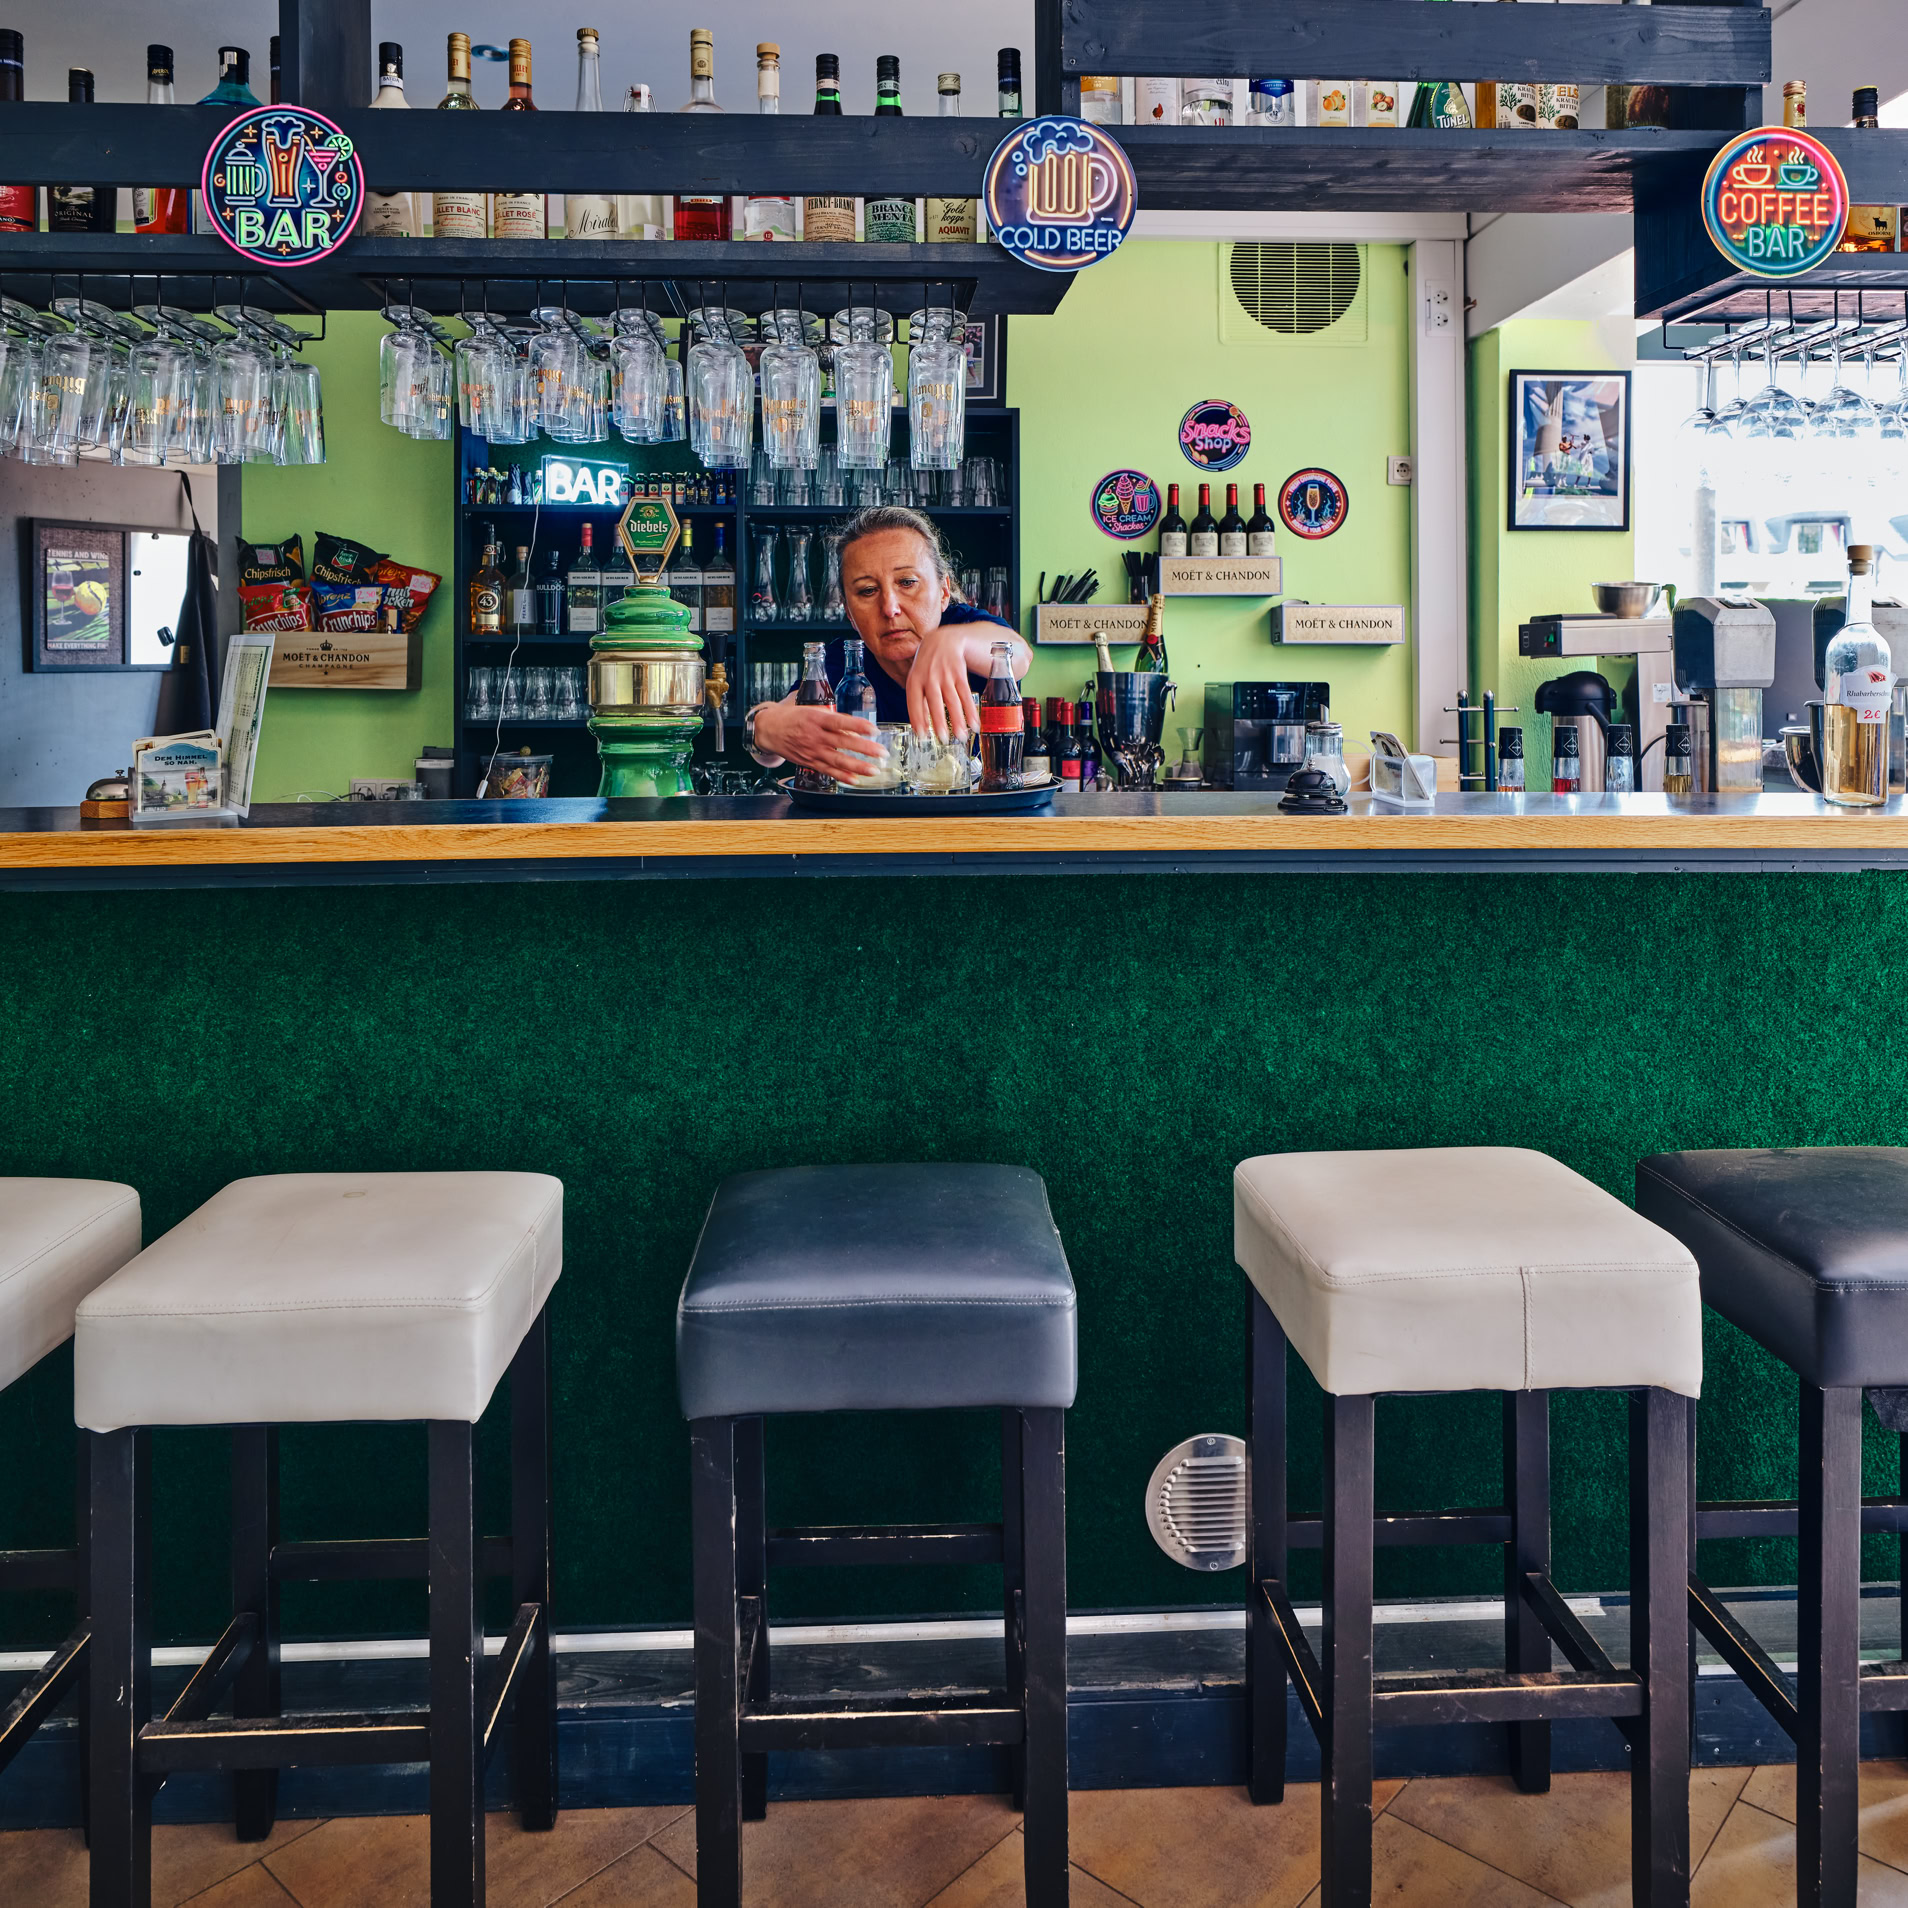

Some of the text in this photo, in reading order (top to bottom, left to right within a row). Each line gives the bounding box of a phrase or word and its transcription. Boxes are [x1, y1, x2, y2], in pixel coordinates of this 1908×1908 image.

[1437, 114, 1468, 128] TÚNEL
[456, 206, 481, 216] BLANC
[872, 204, 913, 215] BRANCA
[943, 201, 966, 214] Gold
[1720, 192, 1830, 226] COFFEE
[54, 211, 94, 219] ORIGINAL
[516, 211, 536, 219] ROSÉ
[872, 212, 914, 224] MENTA
[236, 208, 334, 249] BAR
[938, 226, 970, 235] AQUAVIT
[999, 226, 1122, 252] COLD BEER
[1747, 227, 1805, 258] BAR
[1180, 418, 1251, 445] Snacks
[1195, 436, 1233, 452] Shop
[549, 463, 622, 505] BAR
[1103, 514, 1151, 523] ICE CREAM
[629, 519, 669, 533] diebels
[1112, 522, 1145, 532] Shackes
[48, 549, 73, 558] TENNIS
[74, 551, 89, 559] AND
[245, 566, 292, 580] Chipsfrisch
[314, 564, 362, 586] Chipsfrisch
[377, 566, 407, 579] orenz
[1171, 570, 1271, 581] MOËT & CHANDON
[383, 595, 415, 609] ocken
[479, 594, 494, 607] 43
[317, 611, 376, 633] Crunchips
[1049, 618, 1148, 630] MOËT & CHANDON
[1295, 618, 1393, 630] MOËT & CHANDON
[48, 642, 63, 650] MAKE
[64, 642, 97, 650] EVERYTHING
[282, 652, 312, 662] MOËT
[320, 653, 370, 662] CHANDON
